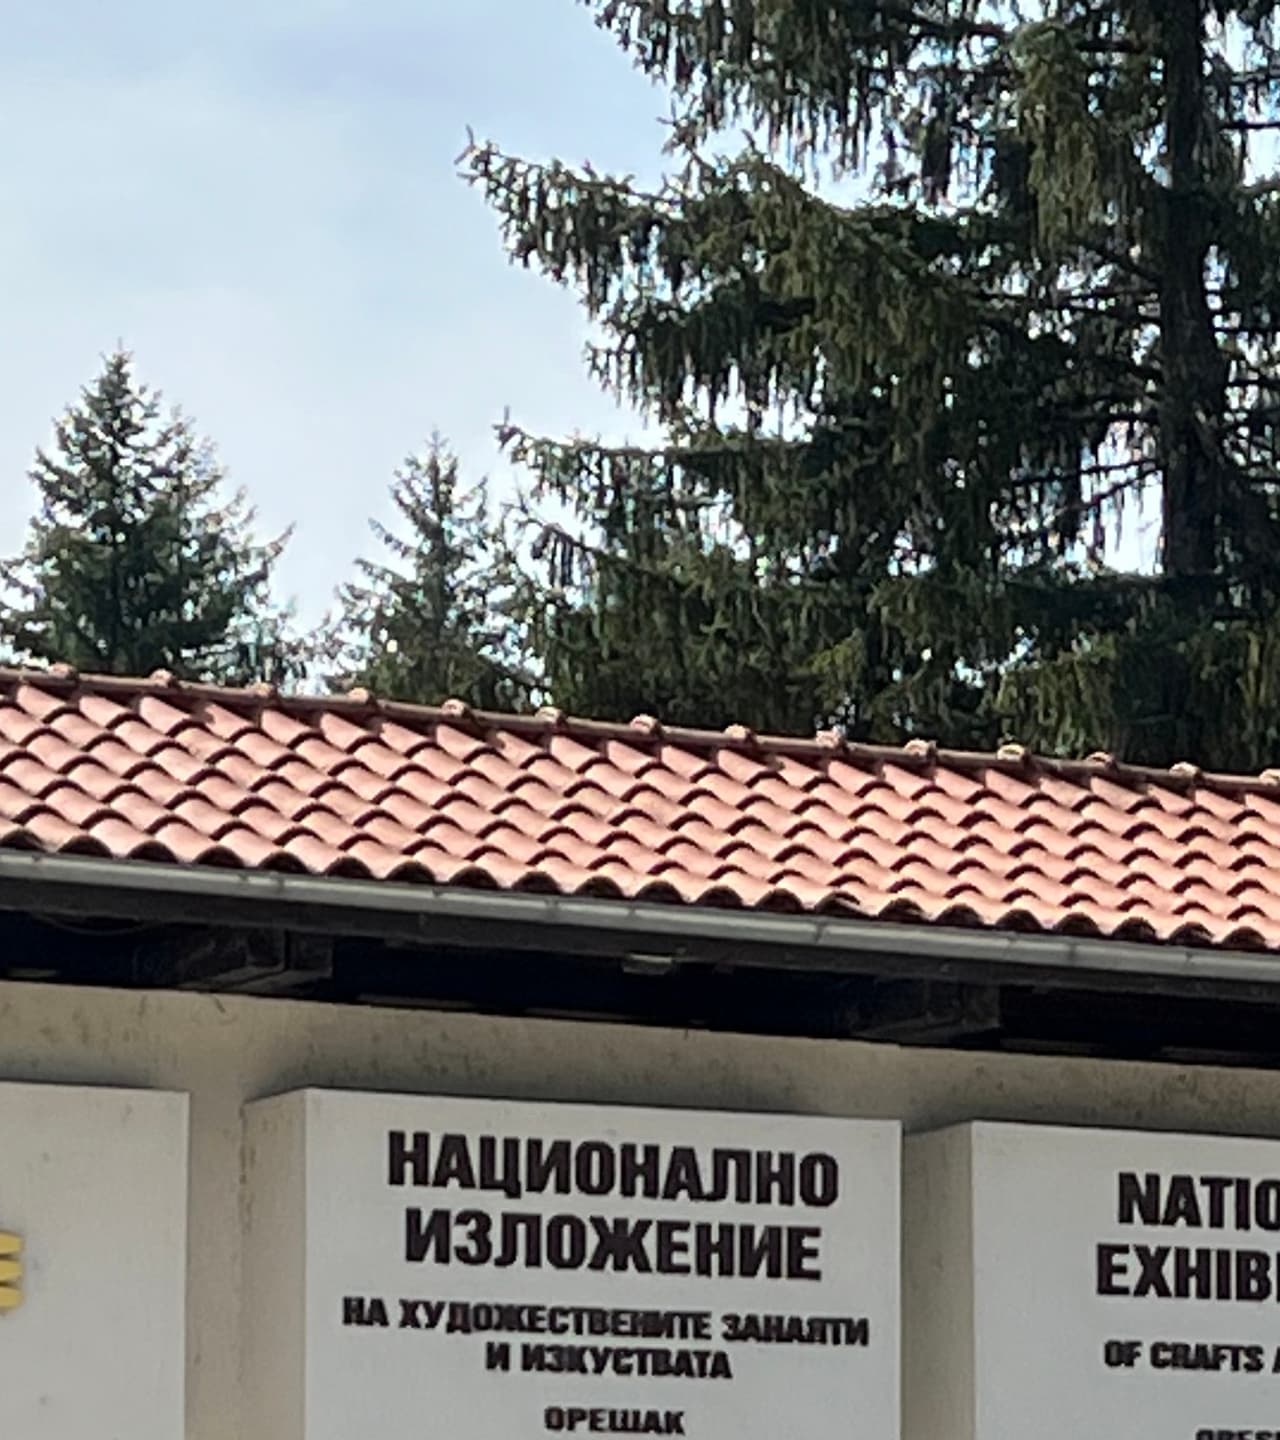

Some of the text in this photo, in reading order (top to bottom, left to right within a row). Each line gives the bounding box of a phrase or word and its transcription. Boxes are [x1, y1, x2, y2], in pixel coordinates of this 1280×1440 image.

[387, 1129, 840, 1209] НАЦИОНАЛНО
[404, 1206, 823, 1283] ИЗЛОЖЕНИЕ
[341, 1295, 871, 1348] НА ХУДОЖЕСТВЕНИТЕ ЗАНАЯТИ
[484, 1340, 735, 1381] И ИЗКУСТВАТА
[1103, 1338, 1144, 1369] OF
[1148, 1340, 1266, 1375] CRAFTS
[543, 1405, 686, 1437] ОРЕШАК
